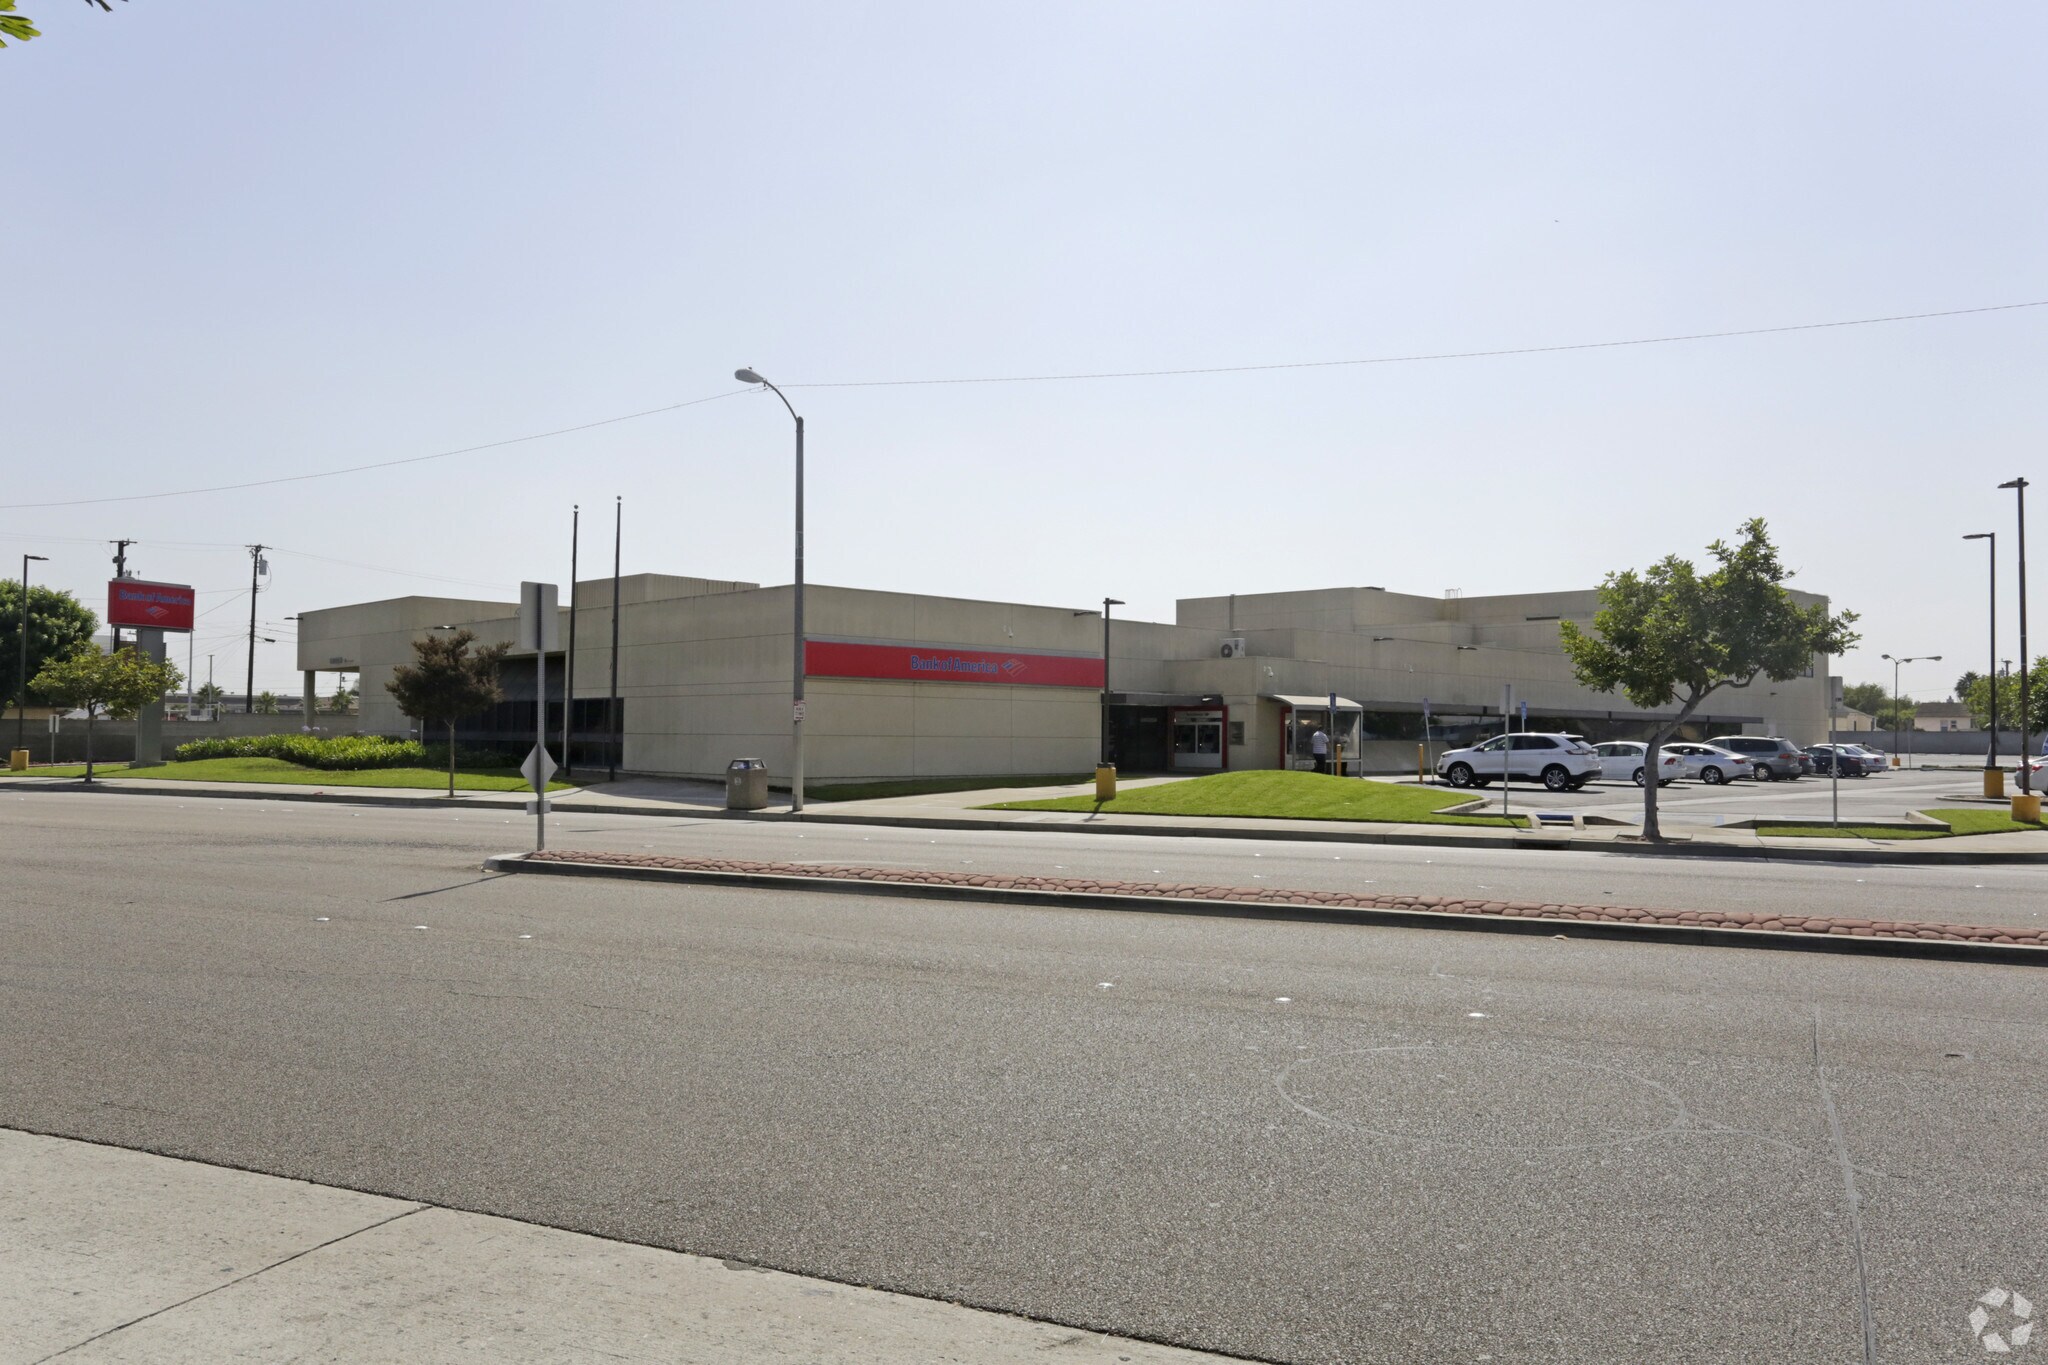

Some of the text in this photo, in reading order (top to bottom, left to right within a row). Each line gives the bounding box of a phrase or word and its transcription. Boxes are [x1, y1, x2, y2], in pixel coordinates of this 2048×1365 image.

[120, 589, 192, 606] Bank of America
[911, 655, 998, 673] Bank of America
